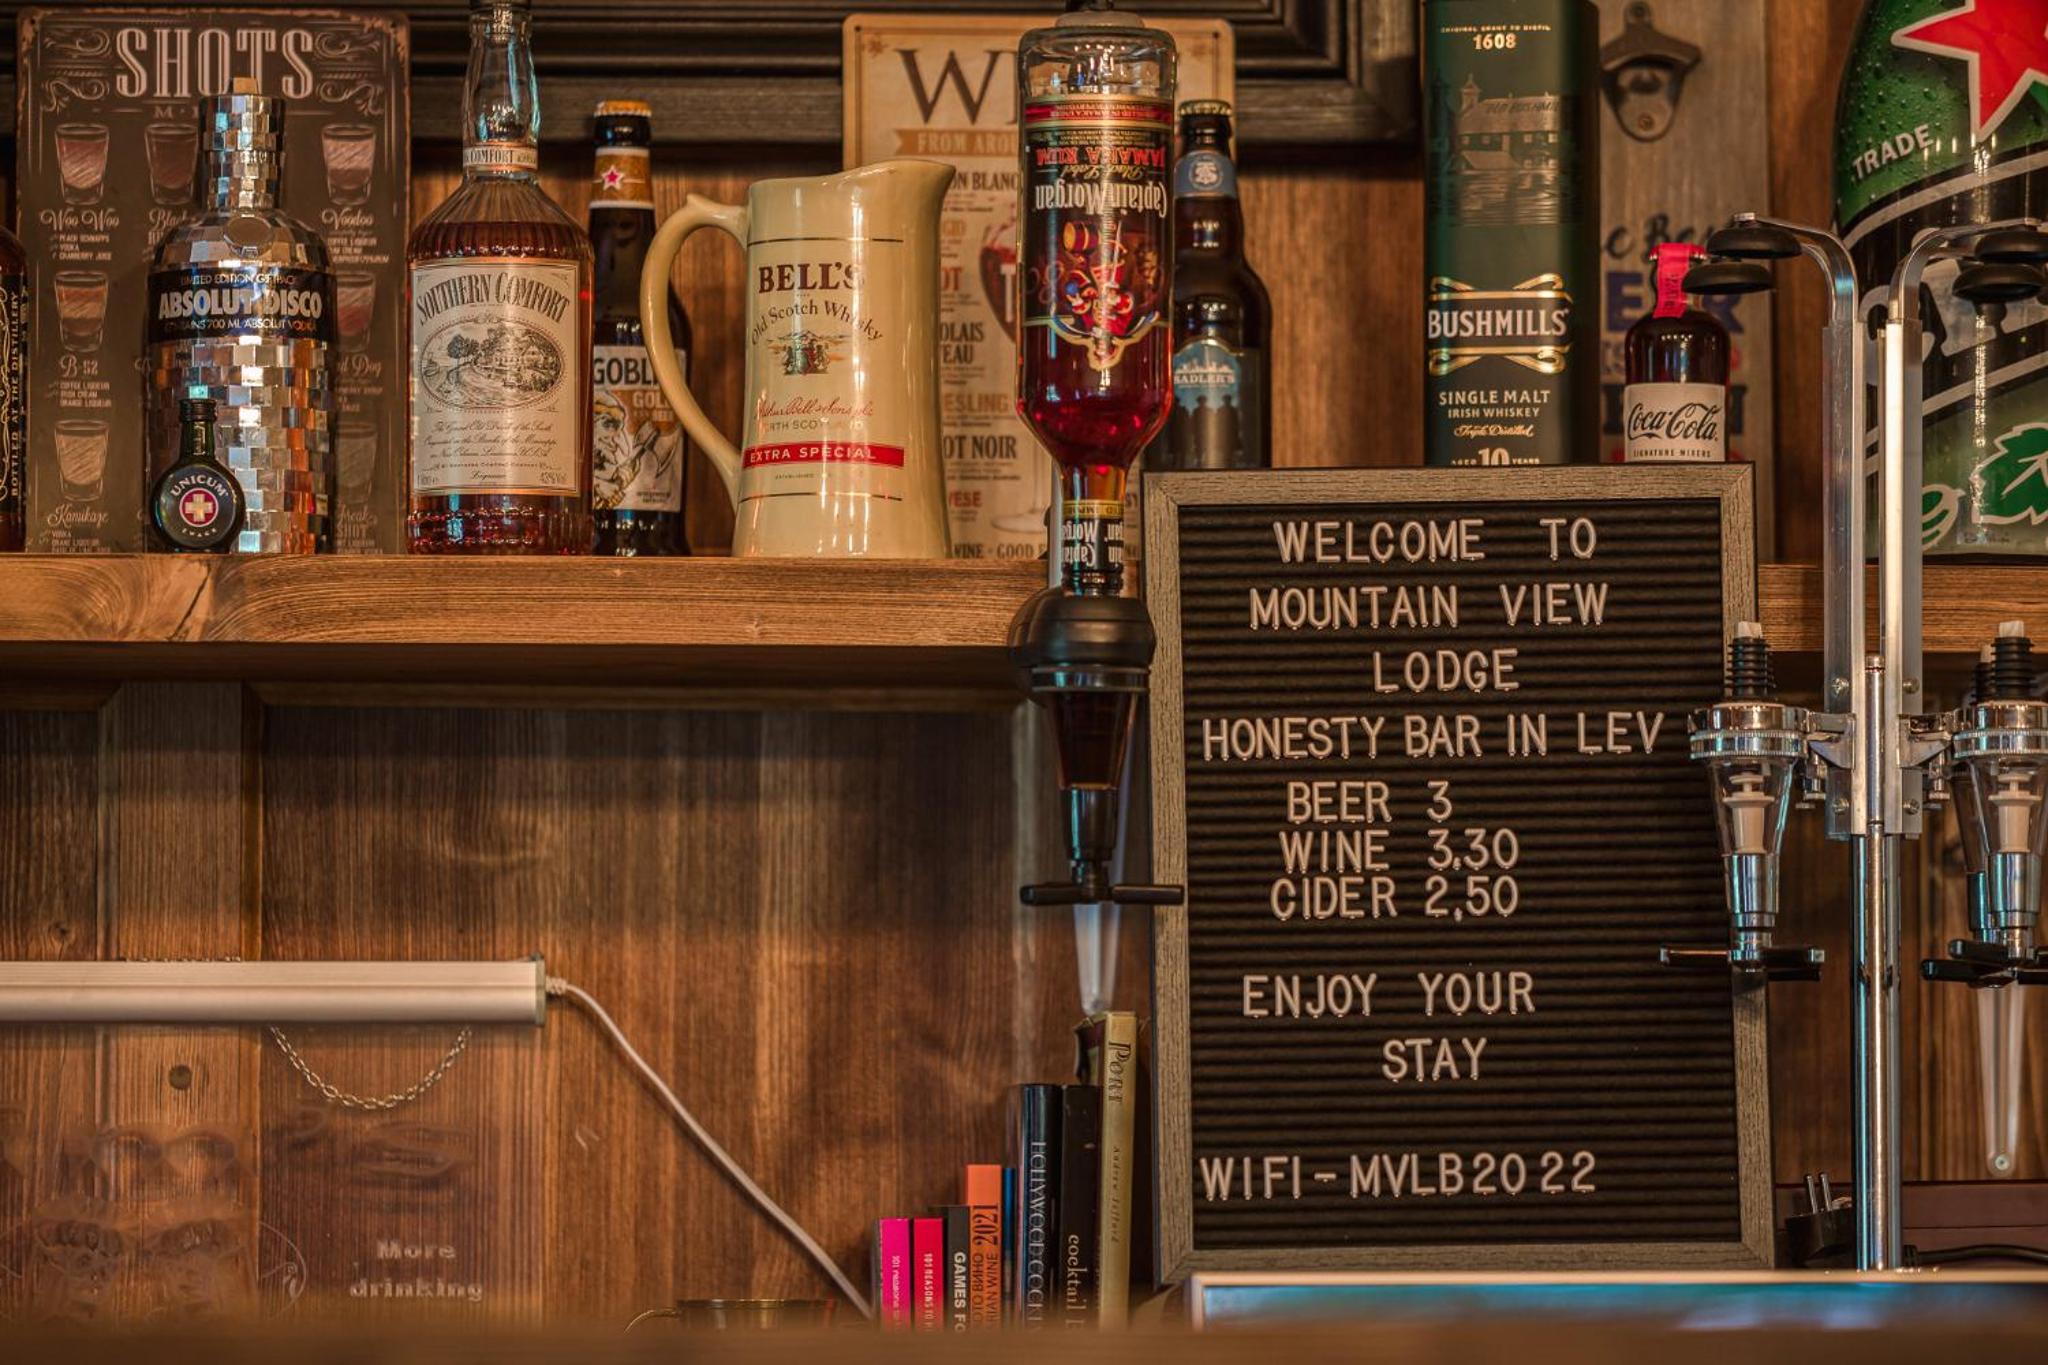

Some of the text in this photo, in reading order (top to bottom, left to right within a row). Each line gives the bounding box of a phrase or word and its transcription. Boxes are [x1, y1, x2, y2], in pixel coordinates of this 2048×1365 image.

[1473, 33, 1517, 50] 1608
[116, 27, 314, 98] SHOTS
[917, 132, 965, 150] FROM
[1035, 146, 1079, 166] RUM
[1852, 123, 1935, 181] TRADE
[1034, 177, 1110, 216] Morgan
[1109, 180, 1168, 219] Captain
[158, 288, 323, 320] ABSOLUT DISCO
[416, 271, 570, 327] SOUTHERN COMFORT
[768, 299, 819, 326] Scotch
[1427, 308, 1567, 339] BUSHMILLS
[593, 357, 657, 386] GOBL
[11, 291, 20, 497] BOTTLED AT THE DISTILLERY
[632, 391, 669, 409] GOL
[944, 392, 1010, 414] ESLING
[1438, 389, 1551, 406] SINGLE MALT
[1447, 406, 1540, 419] IRISH WHISKEY
[1628, 402, 1722, 441] Coca-Cola
[749, 446, 876, 463] EXTRA SPECIAL
[971, 435, 1017, 459] NOIR
[1477, 447, 1511, 466] 10
[1511, 457, 1541, 465] YEARS
[170, 475, 227, 497] UNICUM
[996, 543, 1033, 559] GOOD
[1062, 543, 1096, 568] Capta
[1273, 517, 1597, 563] WELCOME TO
[1249, 582, 1609, 630] MOUNTAIN VIEW
[1373, 648, 1520, 693] LODGE
[1202, 711, 1665, 761] HONESTY BAR IN LEV
[1287, 780, 1454, 824] BEER 3
[1279, 828, 1390, 874] WINE
[1270, 876, 1397, 921] CIDER
[1243, 971, 1536, 1019] ENJOY YOUR
[1382, 1037, 1488, 1083] STAY
[1028, 1141, 1048, 1258] HOLLYWOOD
[972, 1204, 999, 1246] 2021
[376, 1240, 456, 1260] More
[892, 1254, 901, 1268] 101
[923, 1253, 934, 1268] 101
[923, 1269, 934, 1308] REASONS
[953, 1251, 967, 1309] GAMES
[971, 1252, 984, 1292] ВИНО
[986, 1252, 999, 1289] WINE
[1065, 1233, 1088, 1311] cocktail
[350, 1279, 483, 1302] drinking
